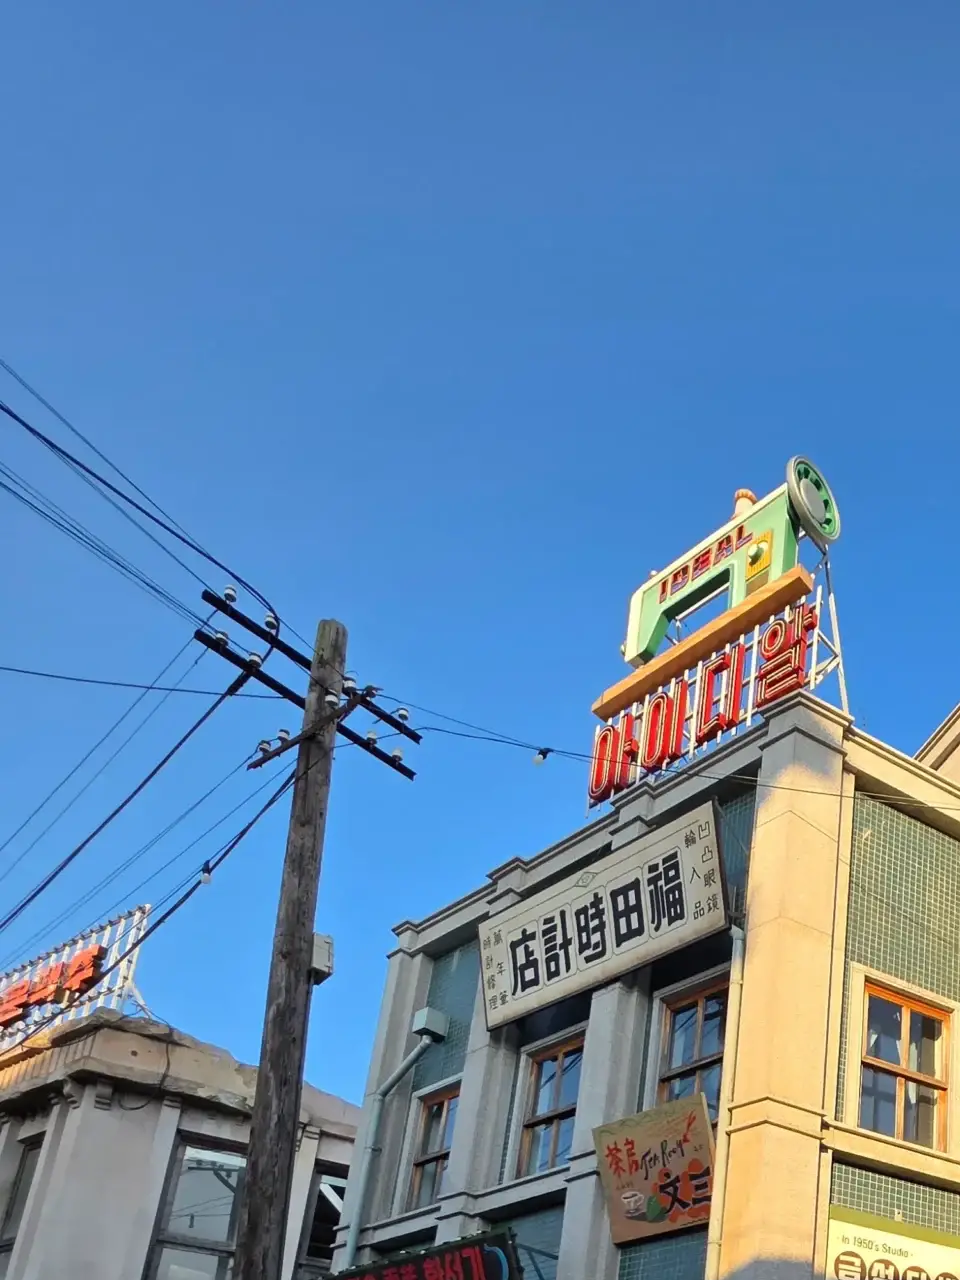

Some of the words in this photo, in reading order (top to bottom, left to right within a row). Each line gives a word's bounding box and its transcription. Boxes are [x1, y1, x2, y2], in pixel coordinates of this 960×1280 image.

[658, 524, 753, 604] IDEAL
[842, 1235, 850, 1245] In
[853, 1236, 879, 1251] 1950's
[882, 1243, 909, 1258] Studio
